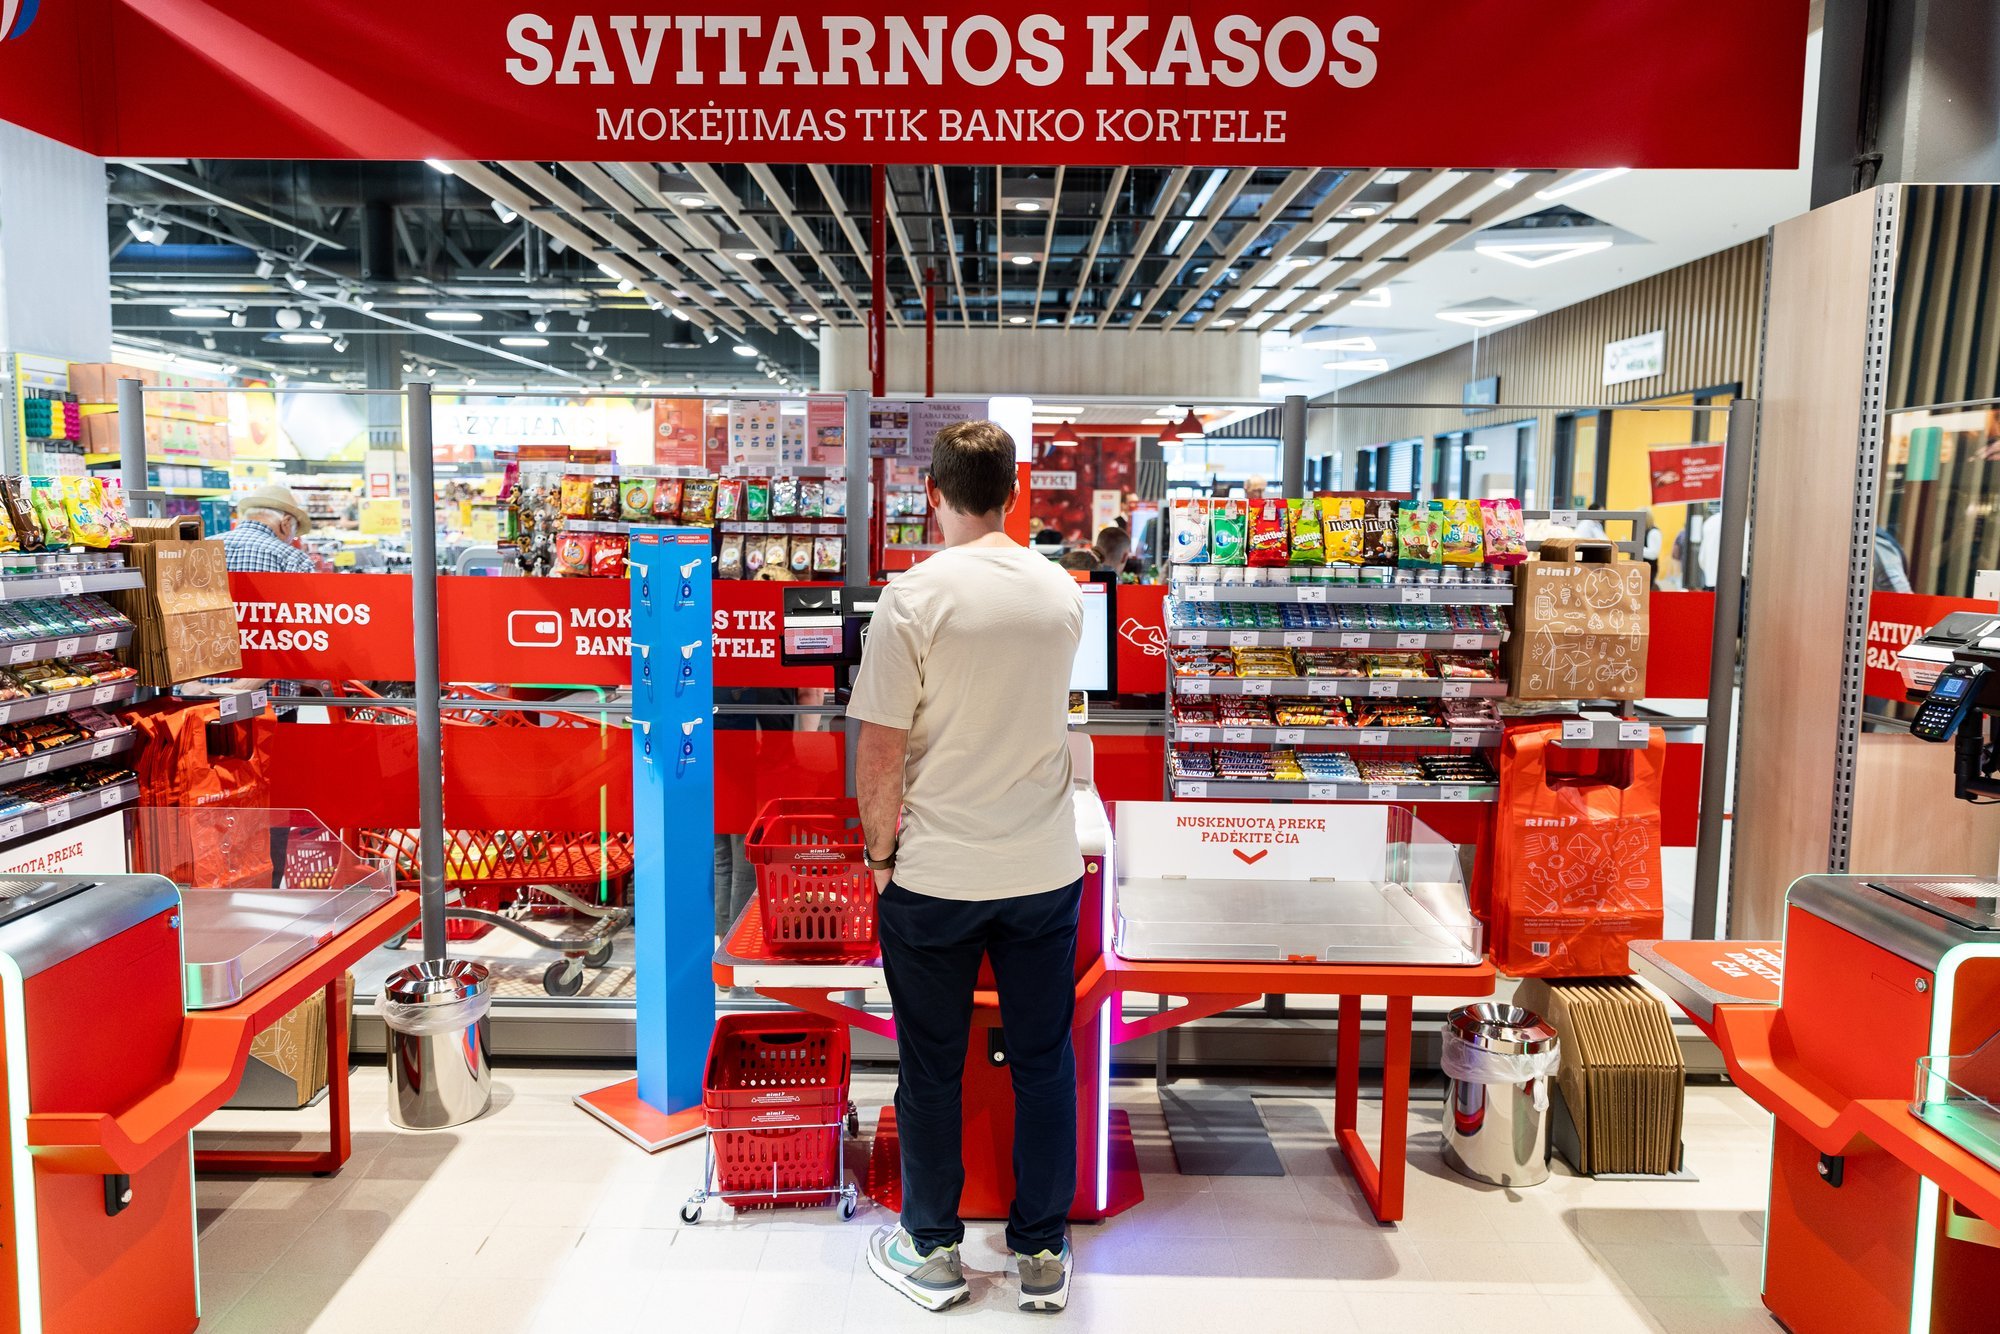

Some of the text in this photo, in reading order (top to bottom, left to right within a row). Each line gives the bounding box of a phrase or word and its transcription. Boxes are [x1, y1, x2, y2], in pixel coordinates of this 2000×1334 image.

[505, 13, 1379, 88] SAVITARNOS KASOS
[596, 100, 1287, 145] MOKĖJIMAS TIK BANKO KORTELE
[1253, 531, 1287, 545] Skittles
[1293, 531, 1322, 546] Skittle
[733, 610, 776, 630] TIK
[239, 629, 329, 651] KASOS
[712, 638, 775, 658] TELE
[1380, 715, 1424, 726] TUPLA
[1177, 817, 1326, 832] NUSKENUOTĄ PREKĘ
[1201, 830, 1300, 844] PADĖKITE ČIA
[47, 842, 83, 867] PREKĘ
